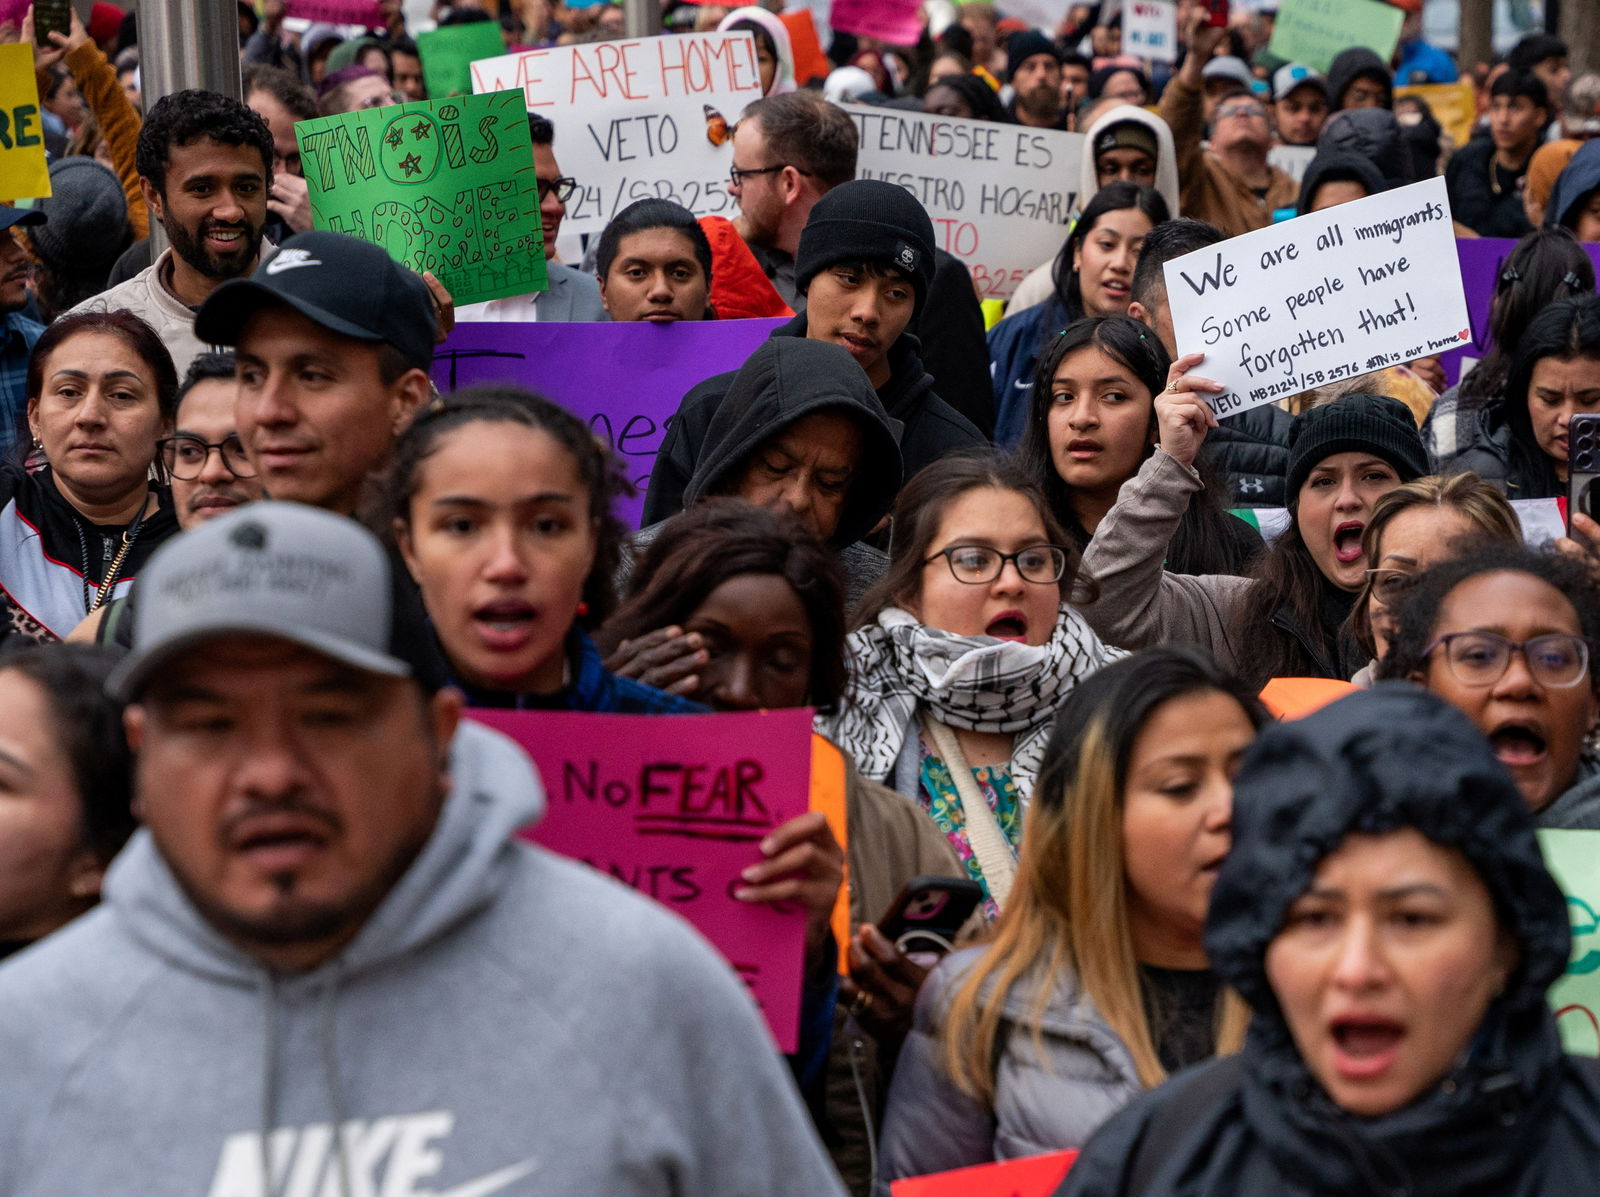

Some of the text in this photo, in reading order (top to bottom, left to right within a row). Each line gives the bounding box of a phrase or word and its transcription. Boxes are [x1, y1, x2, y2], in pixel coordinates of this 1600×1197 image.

[471, 38, 760, 107] WE ARE HOME!
[302, 124, 377, 192] TN
[587, 114, 679, 162] VETO
[1014, 133, 1053, 169] ES
[980, 183, 1078, 225] HOGAR!
[1180, 201, 1449, 297] We are all immigrants.
[1201, 255, 1411, 345] Some people have
[1239, 326, 1345, 378] forgotten
[1358, 292, 1418, 335] that!
[1206, 392, 1242, 415] VETO
[1327, 362, 1360, 380] 2576
[1405, 345, 1424, 358] our
[1427, 333, 1460, 351] home
